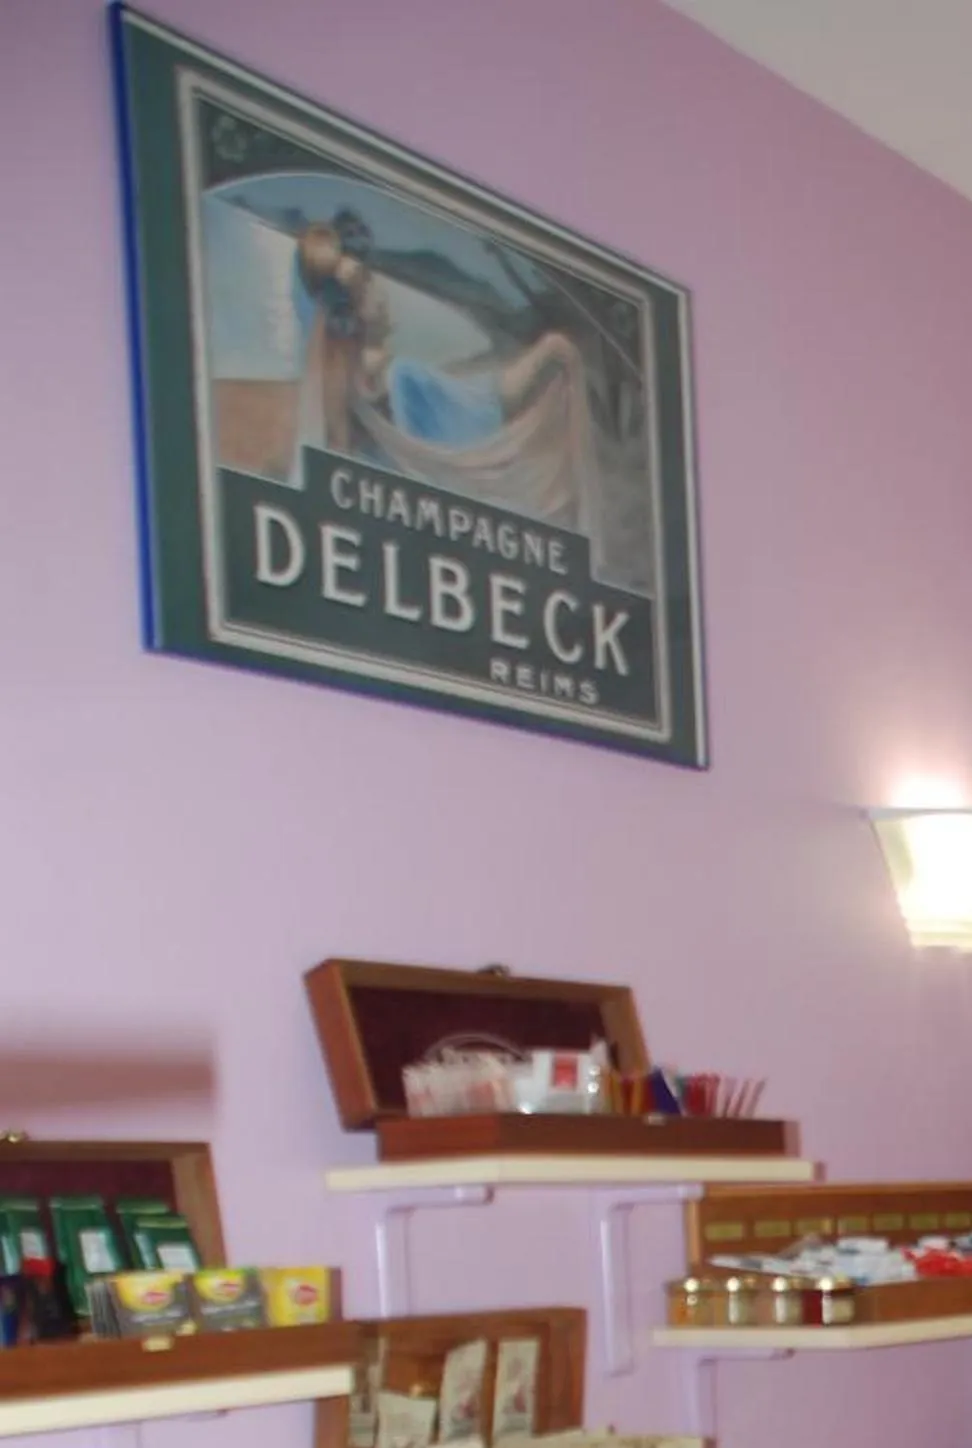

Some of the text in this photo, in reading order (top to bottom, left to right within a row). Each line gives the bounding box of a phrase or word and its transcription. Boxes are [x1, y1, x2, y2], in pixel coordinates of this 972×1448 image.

[331, 469, 568, 575] CHAMPAGNE
[254, 504, 630, 676] DELBECK
[490, 660, 600, 705] REIMS
